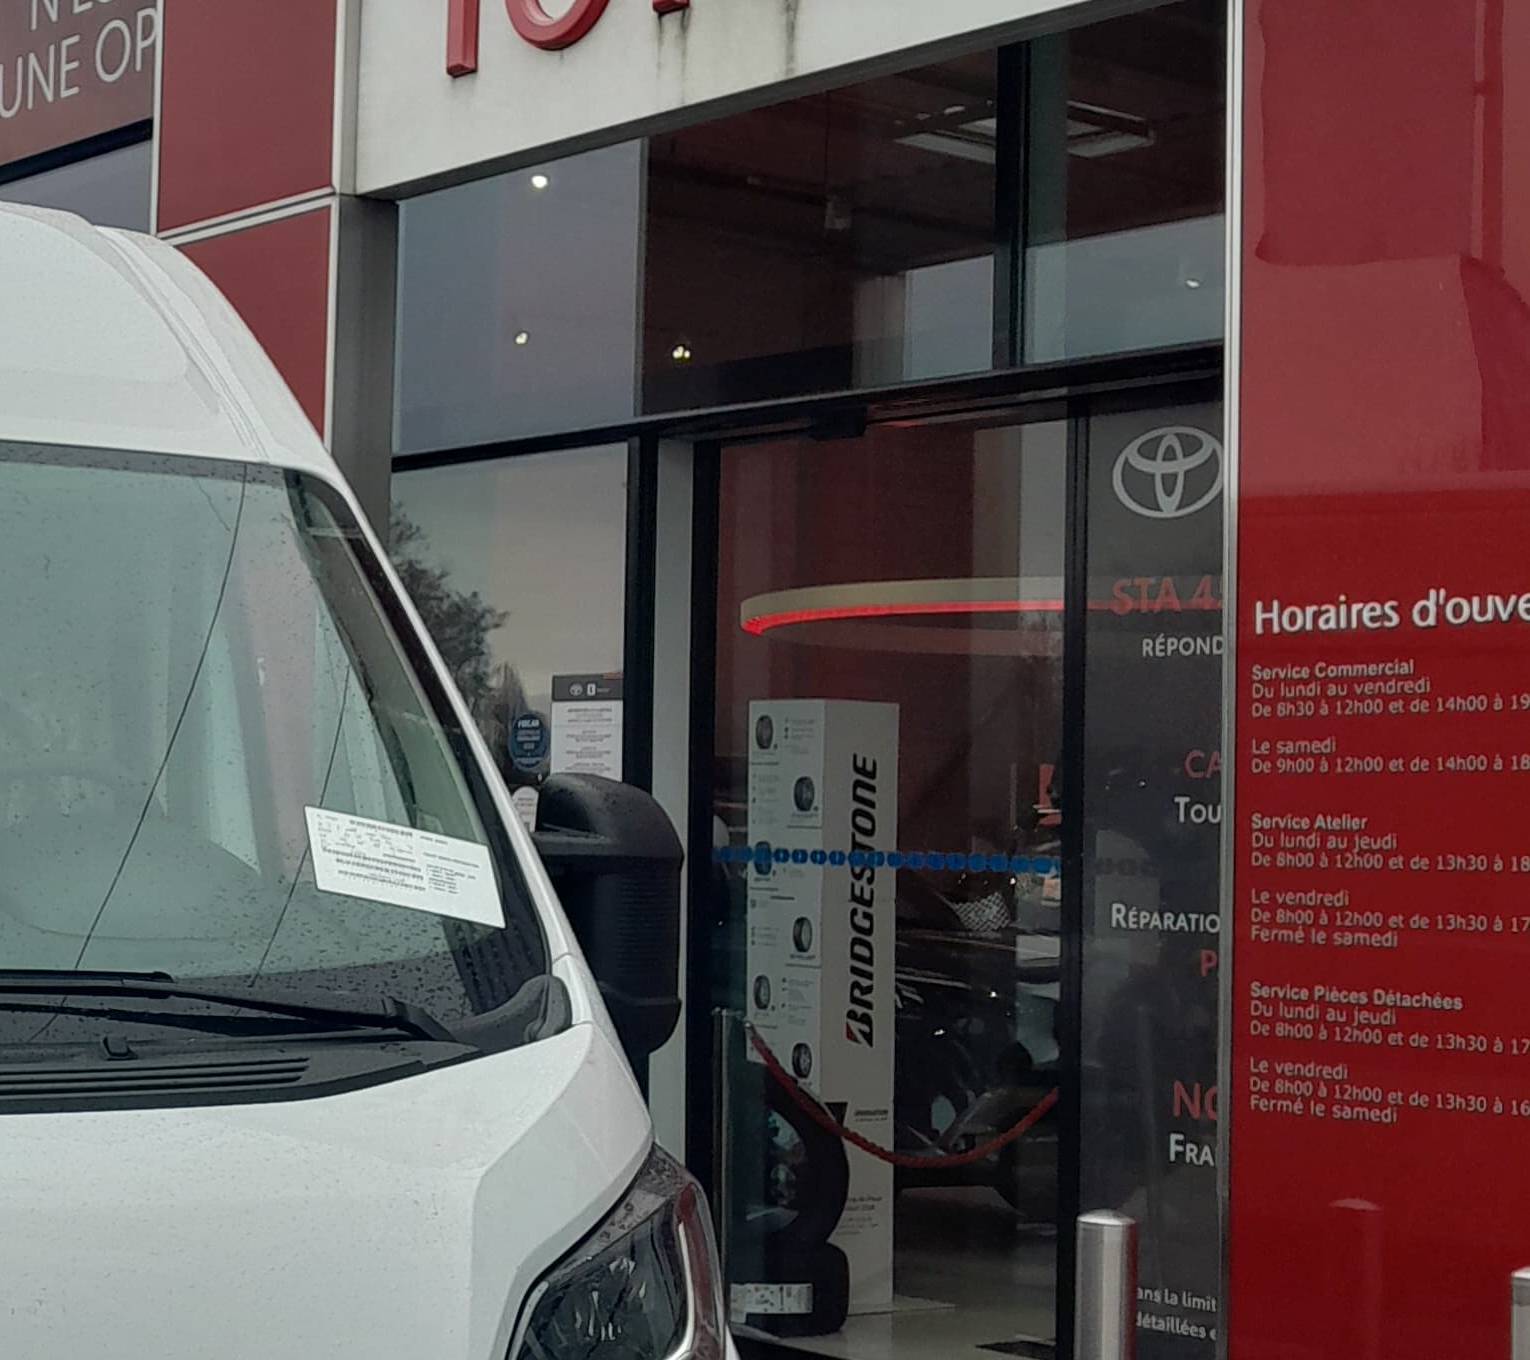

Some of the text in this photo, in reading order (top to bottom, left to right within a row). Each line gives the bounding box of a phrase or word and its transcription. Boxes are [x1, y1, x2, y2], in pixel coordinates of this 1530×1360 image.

[95, 7, 157, 82] OP
[1111, 575, 1223, 615] STA 4
[1255, 595, 1400, 634] Horaires
[1142, 633, 1224, 657] RÉPOND
[1252, 658, 1414, 681] Service Commercial
[1252, 678, 1430, 699] Du lundi au vendredi
[1252, 703, 1271, 717] De
[1320, 700, 1329, 715] à
[1336, 699, 1383, 714] 12h00
[1389, 700, 1404, 714] et
[1410, 698, 1430, 713] de
[1437, 695, 1488, 712] 14h00
[1493, 693, 1503, 711] à
[1252, 737, 1336, 755] Le samedi
[1252, 758, 1271, 773] De
[1277, 758, 1314, 773] 9h00
[1320, 756, 1329, 773] à
[1336, 757, 1383, 772] 12h00
[1389, 758, 1404, 772] et
[1410, 756, 1430, 771] de
[1437, 755, 1488, 771] 14h00
[1493, 753, 1503, 770] à
[1251, 813, 1368, 830] Service Atelier
[1251, 832, 1397, 853] Du lundi au jeudi
[1251, 852, 1271, 867] De
[1276, 852, 1314, 868] 8h00
[1320, 851, 1328, 868] à
[1335, 852, 1383, 869] 12h00
[1388, 855, 1404, 870] et
[1410, 854, 1430, 871] de
[1437, 854, 1488, 871] 13h30
[1493, 854, 1503, 872] à
[846, 753, 878, 1048] BRIDGESTONE
[1251, 889, 1349, 907] Le vendredi
[1251, 908, 1271, 923] De
[1276, 908, 1314, 925] 8h00
[1320, 908, 1328, 926] à
[1335, 911, 1383, 927] 12h00
[1388, 914, 1404, 928] et
[1410, 913, 1430, 930] de
[1437, 914, 1488, 932] 13h30
[1493, 914, 1503, 932] à
[1251, 925, 1398, 948] Fermé le samedi
[1250, 981, 1463, 1010] Service Pièces Détachées
[1250, 1000, 1397, 1027] Du lundi au jeudi
[1250, 1020, 1270, 1036] De
[1275, 1022, 1313, 1039] 8h00
[1318, 1023, 1327, 1041] à
[1334, 1026, 1382, 1045] 12h00
[1388, 1031, 1404, 1046] et
[1409, 1031, 1429, 1048] de
[1437, 1034, 1487, 1052] 13h30
[1493, 1035, 1503, 1054] à
[1250, 1057, 1348, 1080] Le vendredi
[1250, 1077, 1270, 1093] De
[1318, 1080, 1327, 1098] à
[1333, 1084, 1382, 1103] 12h00
[1388, 1090, 1403, 1105] et
[1409, 1090, 1429, 1108] de
[1437, 1094, 1487, 1113] 13h30
[1493, 1096, 1503, 1114] à
[1250, 1095, 1397, 1124] Fermé le samedi
[1164, 1287, 1178, 1306] la
[1182, 1291, 1216, 1313] limit
